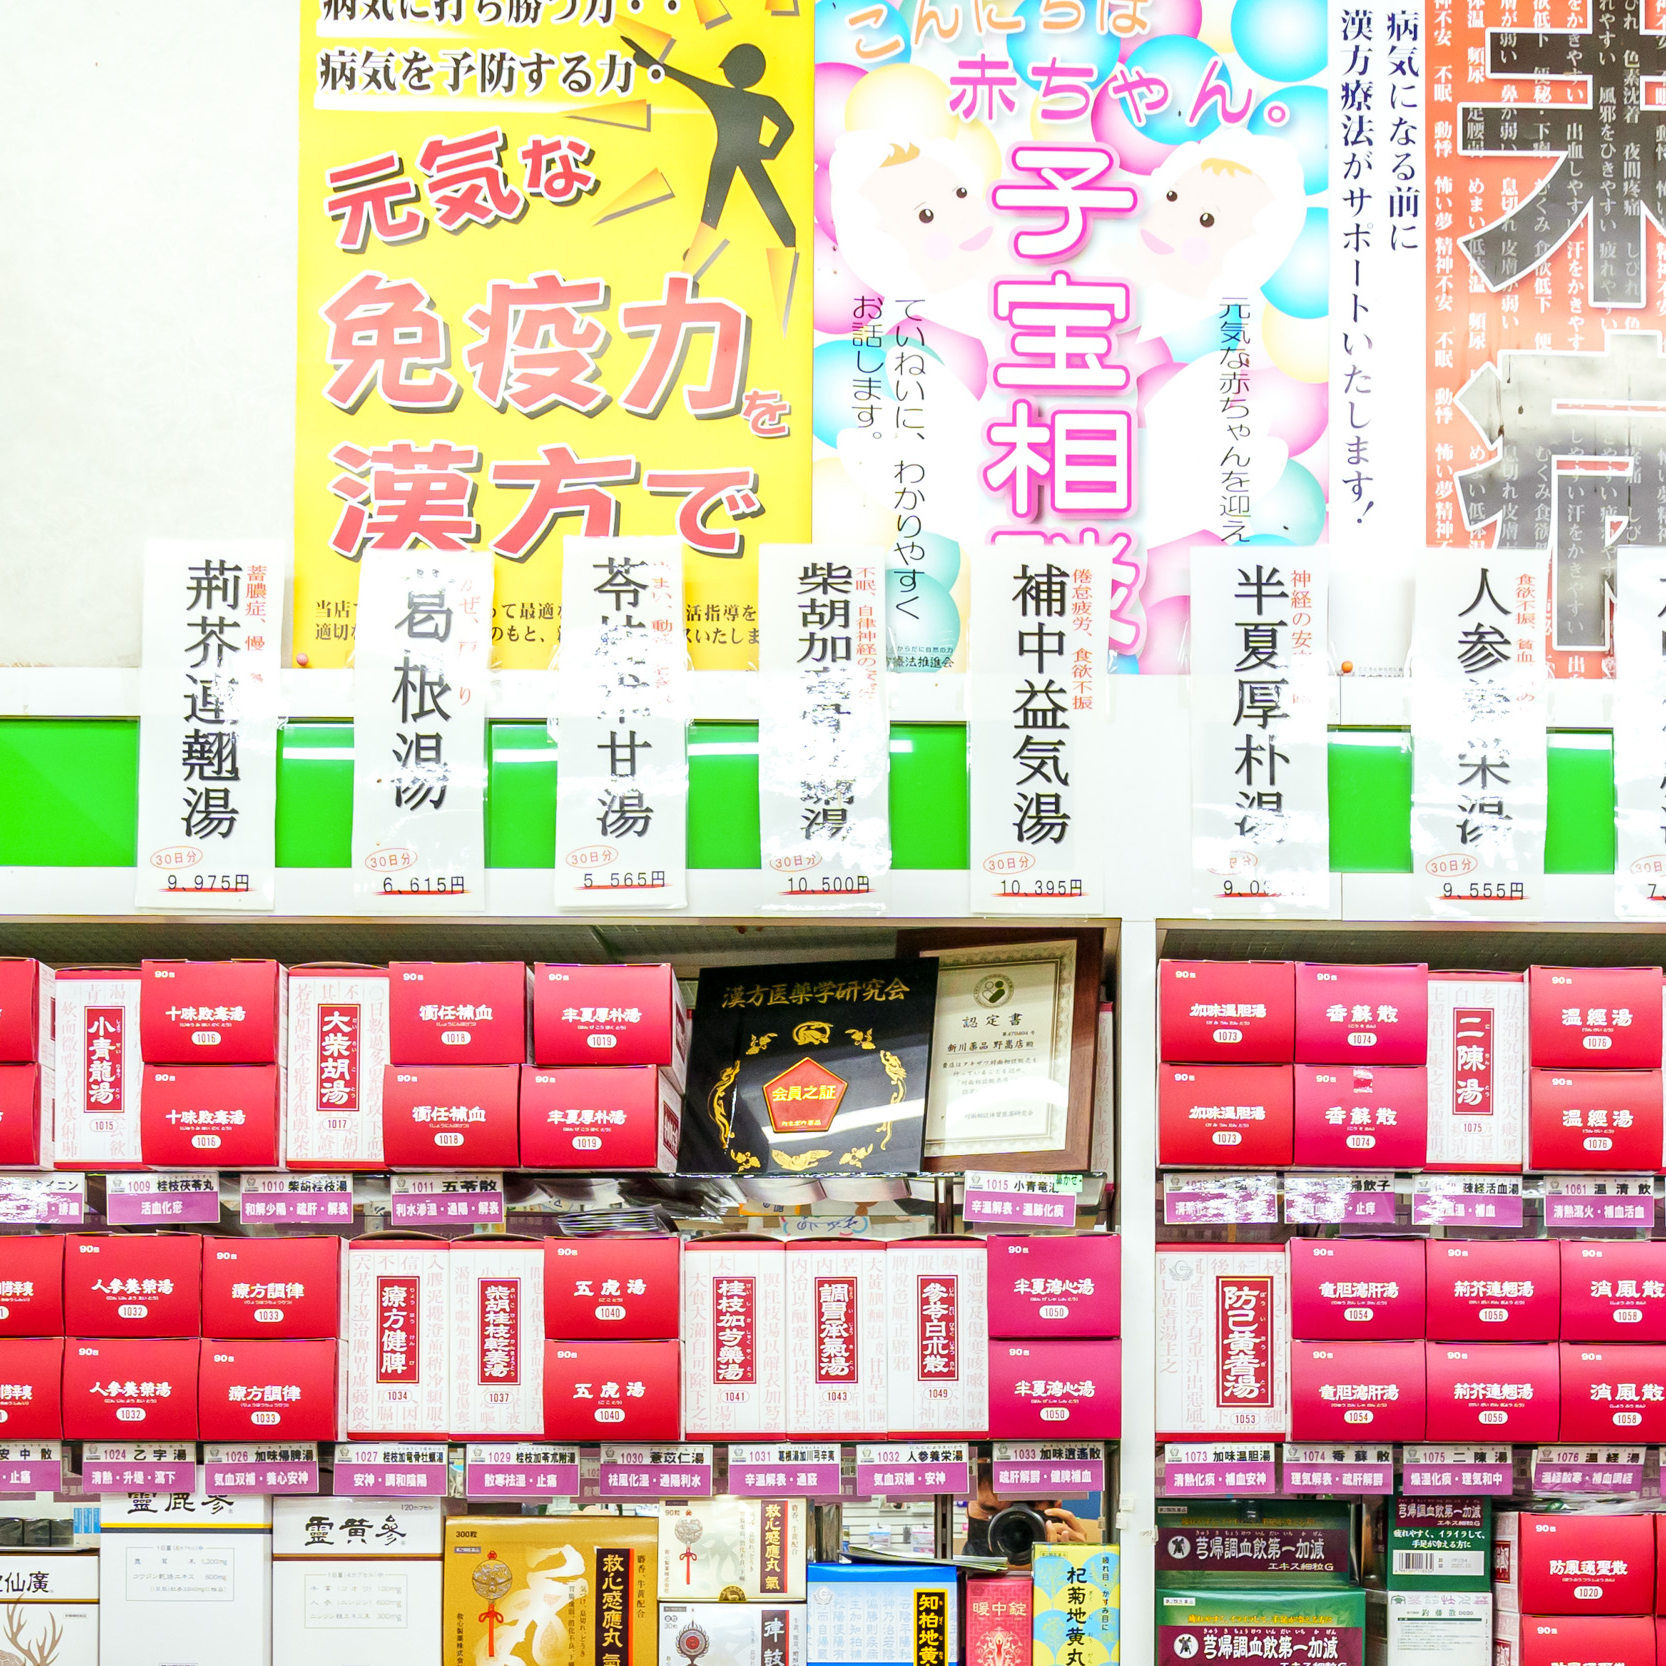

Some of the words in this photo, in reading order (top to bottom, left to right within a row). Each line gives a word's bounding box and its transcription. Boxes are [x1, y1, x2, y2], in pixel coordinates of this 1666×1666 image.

[949, 52, 1289, 125] 赤ちゃん。
[1386, 8, 1420, 252] 病気になる前に
[1434, 119, 1453, 159] 動悸
[327, 127, 597, 251] 元気な
[321, 272, 789, 439] 免疫力を
[851, 295, 884, 440] お話します。
[1219, 297, 1252, 542] 元気な赤ちゃんを迎え
[327, 441, 764, 562] 漢方で
[391, 567, 454, 811] 葛根湯
[1012, 562, 1071, 846] 補中益気湯
[1232, 563, 1291, 845] 半夏厚朴湯
[370, 853, 413, 868] 30日分
[562, 1007, 642, 1024] 半夏厚朴湯
[722, 976, 910, 1009] 漢方医薬学研究会
[1326, 1004, 1399, 1024] 香蘇散
[88, 1015, 115, 1104] 小青龍湯
[320, 1010, 351, 1105] 大柴胡湯
[1456, 1016, 1485, 1107] 二陳湯
[1588, 1037, 1607, 1048] 1076
[772, 1084, 836, 1102] 会員之証
[261, 1181, 284, 1192] 1010
[573, 1278, 647, 1298] 五虎湯
